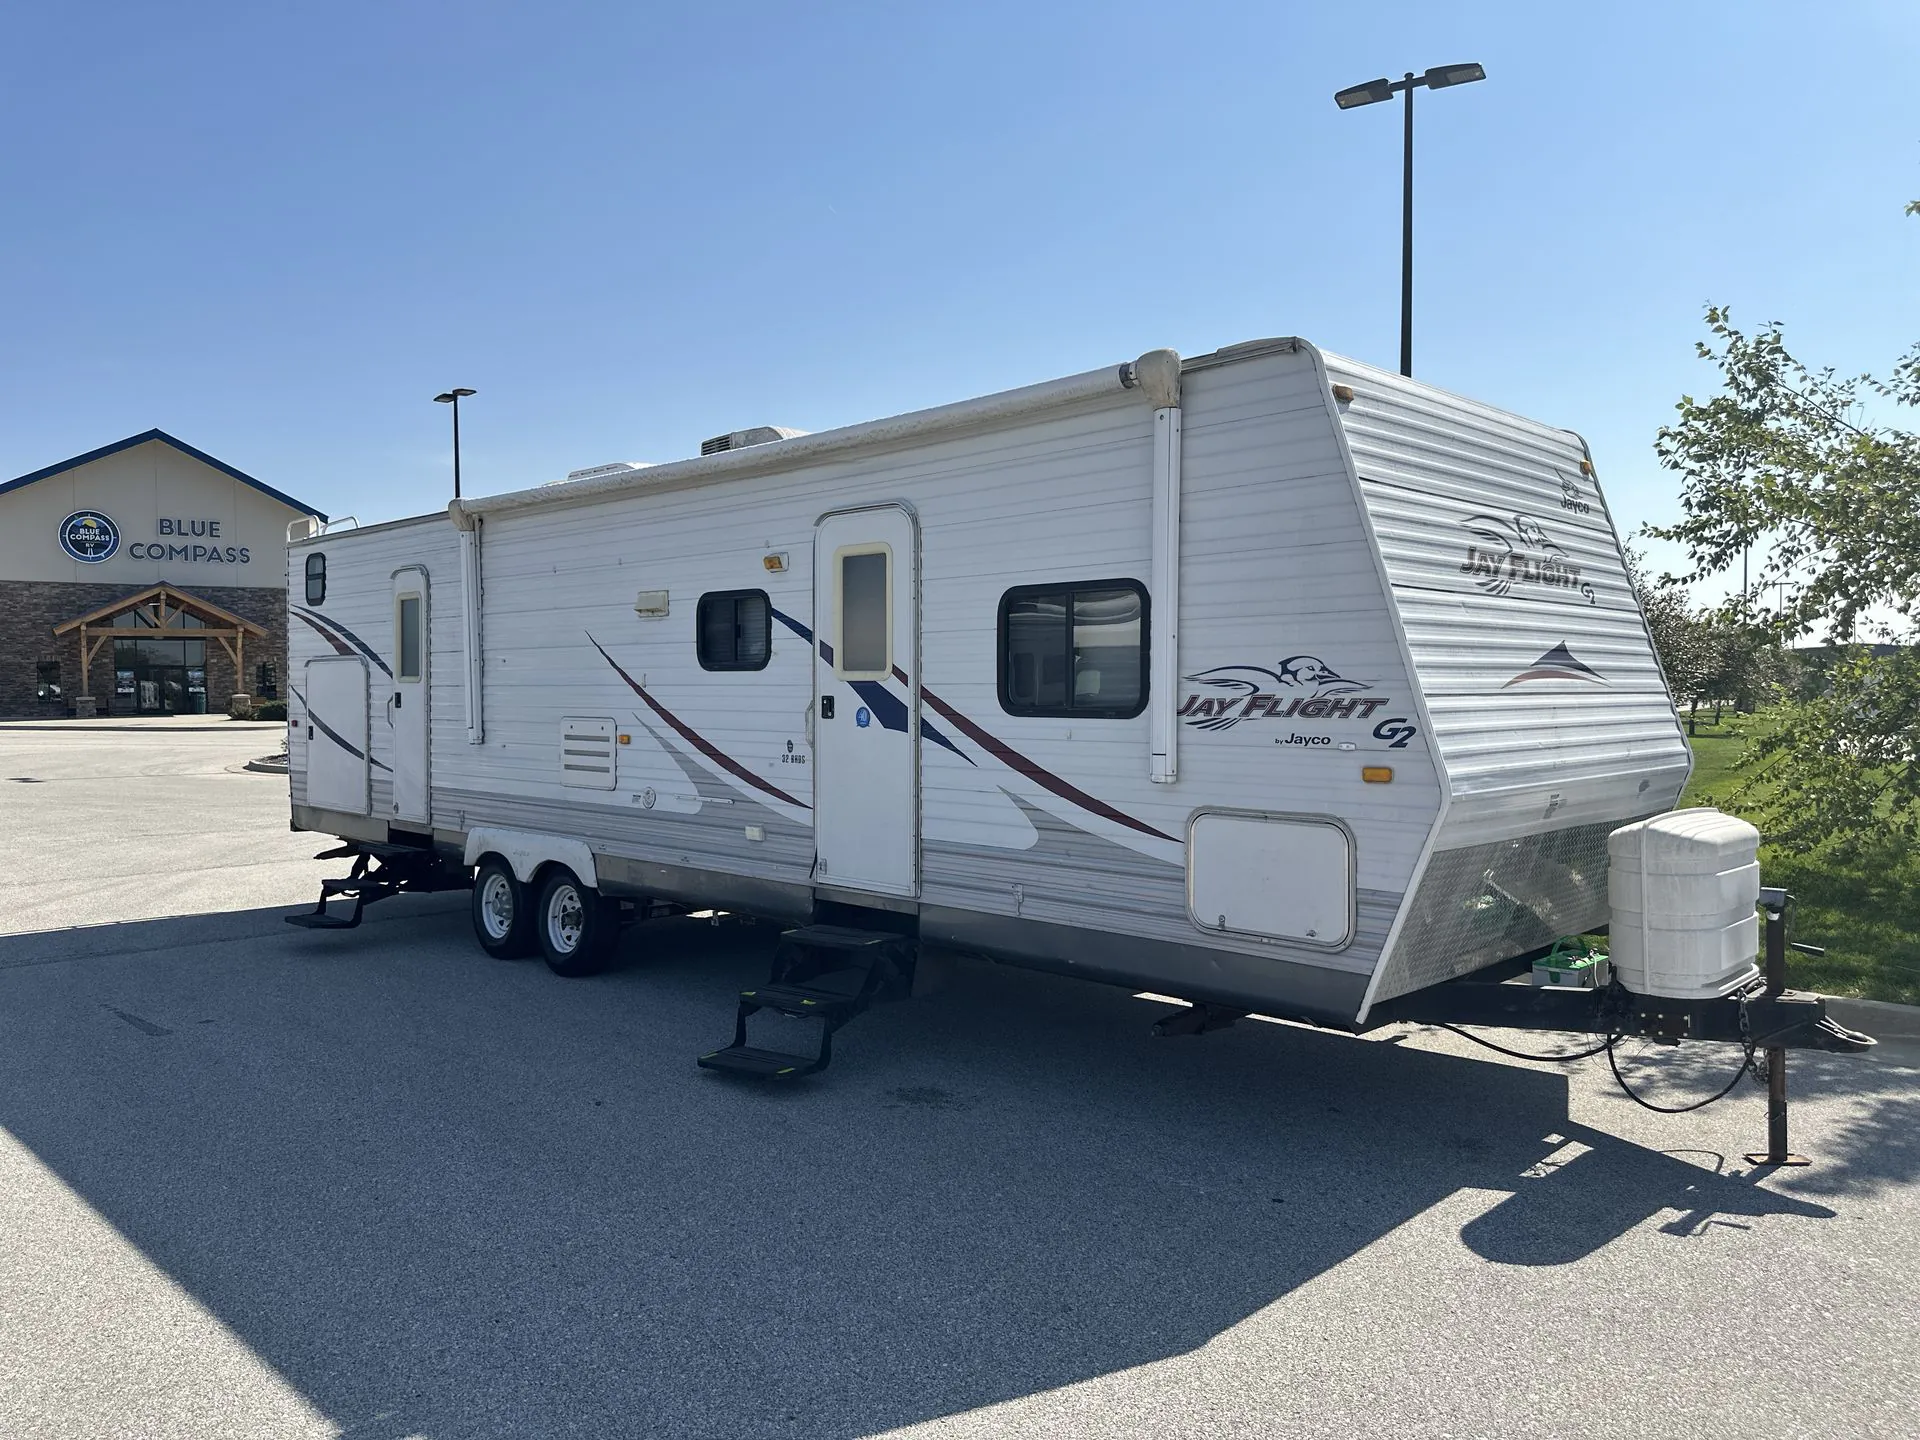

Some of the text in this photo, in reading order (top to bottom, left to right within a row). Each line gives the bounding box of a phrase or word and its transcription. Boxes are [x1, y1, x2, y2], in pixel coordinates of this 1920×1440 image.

[1560, 493, 1590, 514] Jayco
[159, 518, 221, 538] BLUE
[129, 542, 251, 564] COMPASS
[1460, 547, 1580, 588] JAY FLIGHT
[1177, 694, 1390, 719] JAY FLIGHT
[1285, 733, 1331, 747] Jayco
[1372, 718, 1417, 748] G2
[782, 754, 790, 763] 32
